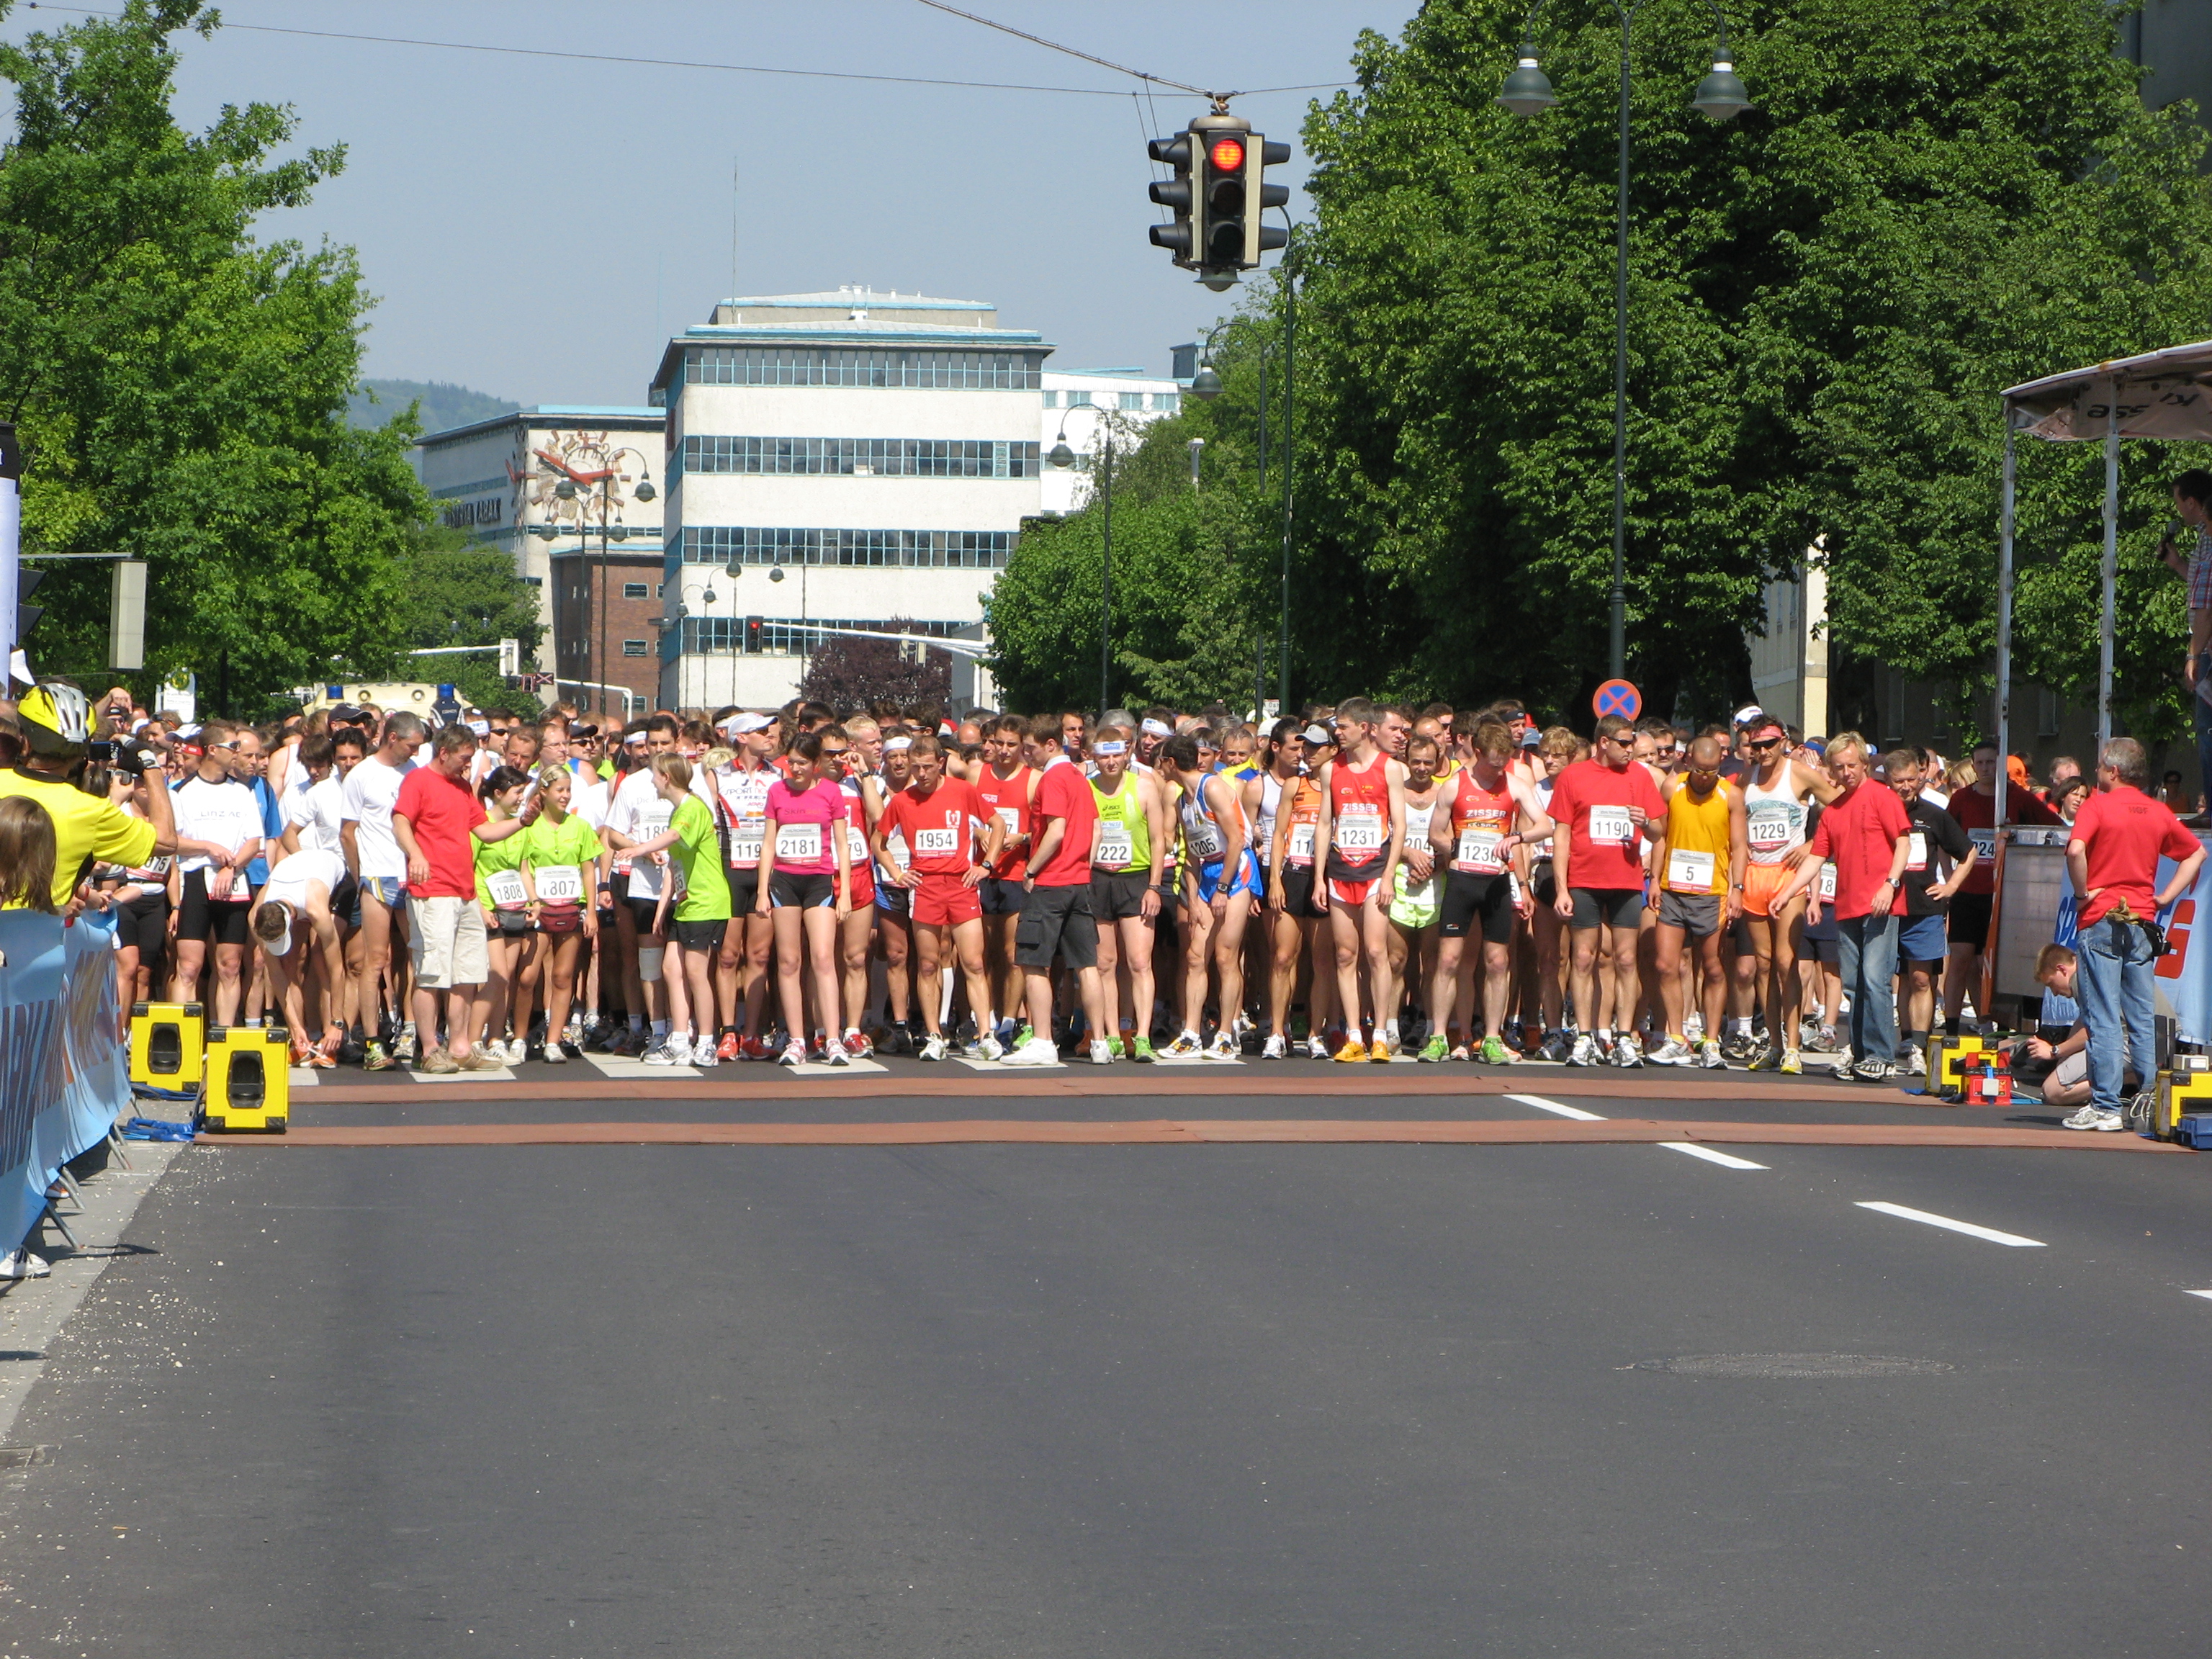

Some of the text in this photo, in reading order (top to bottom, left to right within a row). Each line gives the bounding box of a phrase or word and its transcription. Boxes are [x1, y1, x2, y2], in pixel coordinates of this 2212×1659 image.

[1341, 802, 1378, 812] ZISSER
[1465, 809, 1507, 818] ZISSER
[1596, 821, 1629, 837] 1190
[1753, 823, 1786, 840] 1229
[919, 832, 953, 848] 1954
[1341, 830, 1375, 845] 1231
[781, 839, 815, 855] 2181
[1190, 837, 1217, 856] 1205
[1686, 866, 1695, 881] 5
[495, 884, 523, 902] 1808
